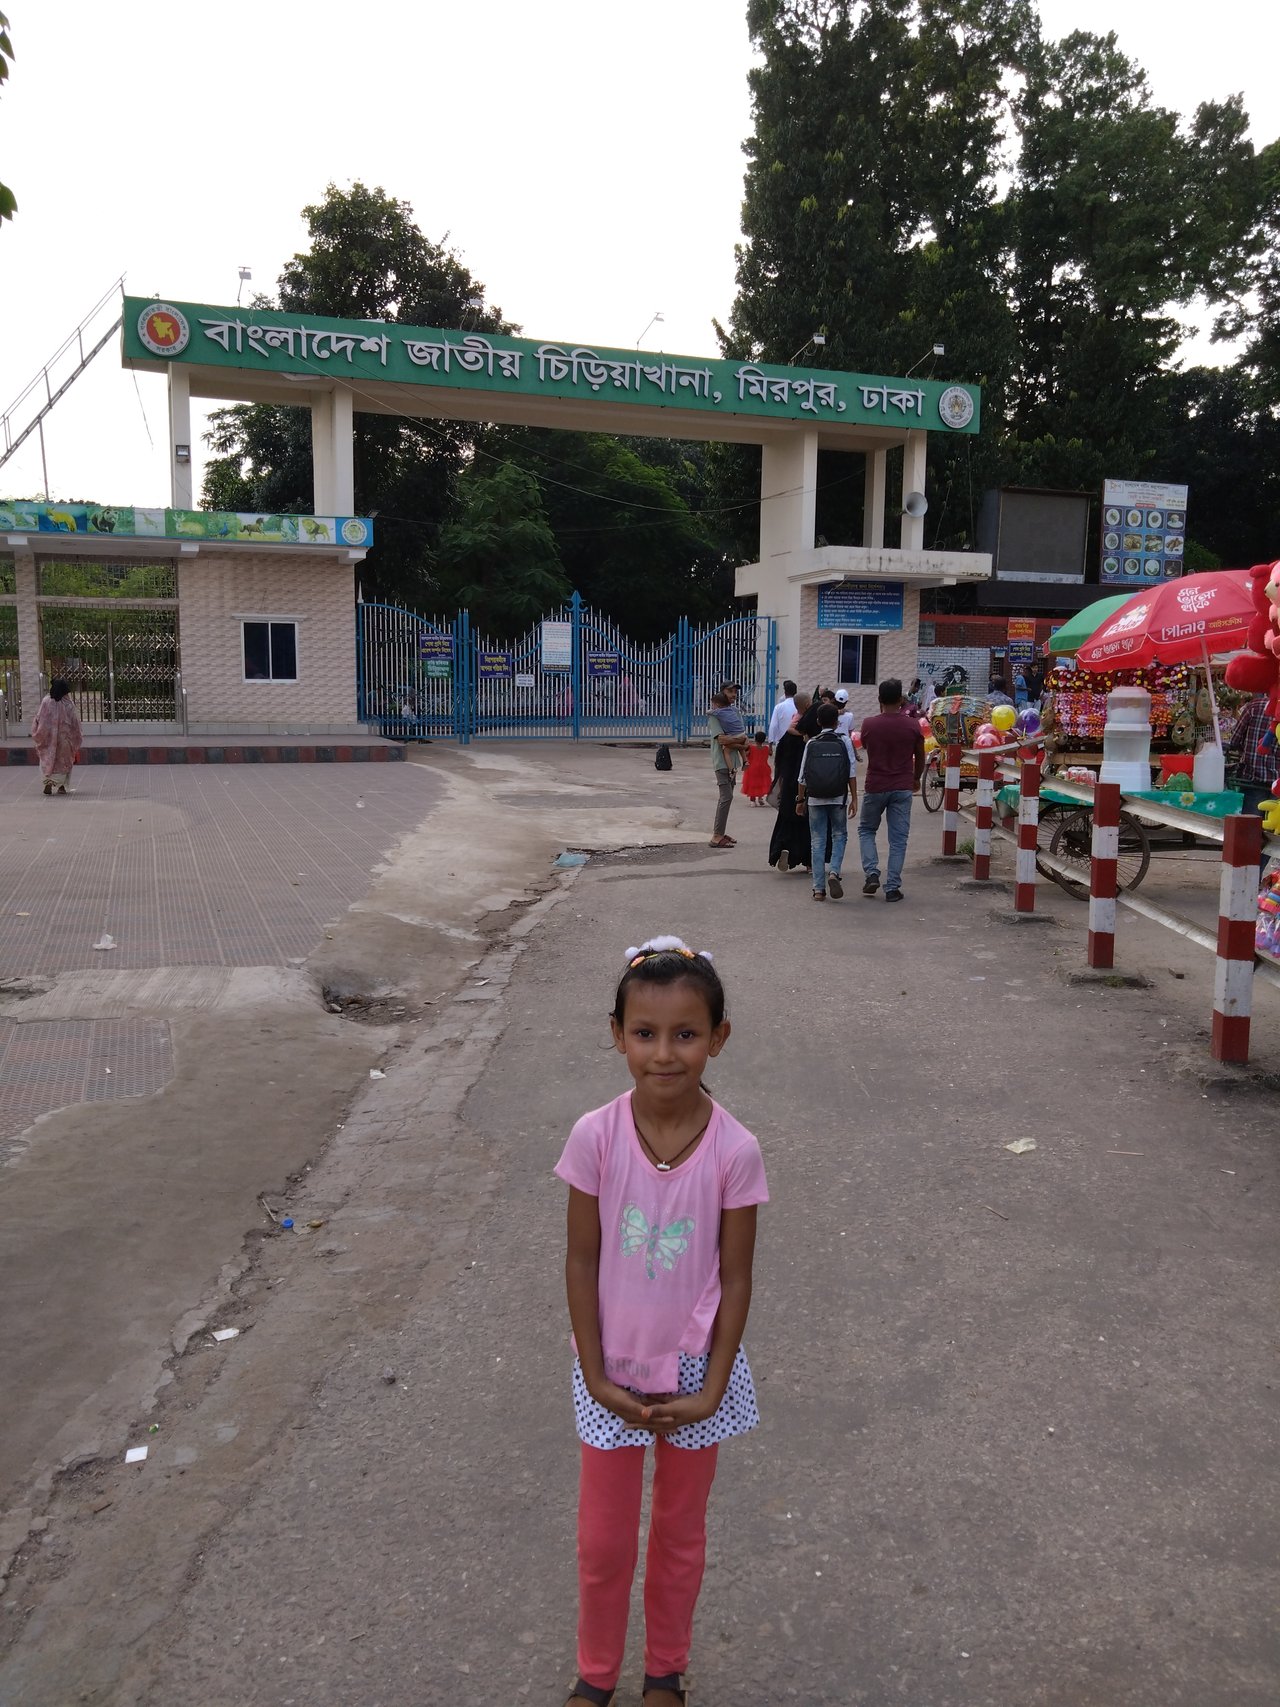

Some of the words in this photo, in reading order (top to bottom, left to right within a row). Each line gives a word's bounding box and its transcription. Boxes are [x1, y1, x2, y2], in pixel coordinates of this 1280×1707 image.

[197, 318, 392, 366] বাংলাদেশ
[402, 336, 525, 380] জাতীয়
[533, 344, 722, 404] চিড়িয়াখানা,
[734, 366, 847, 415] মিরপুর,
[858, 384, 927, 417] ঢাকা
[1161, 620, 1205, 640] পোলার
